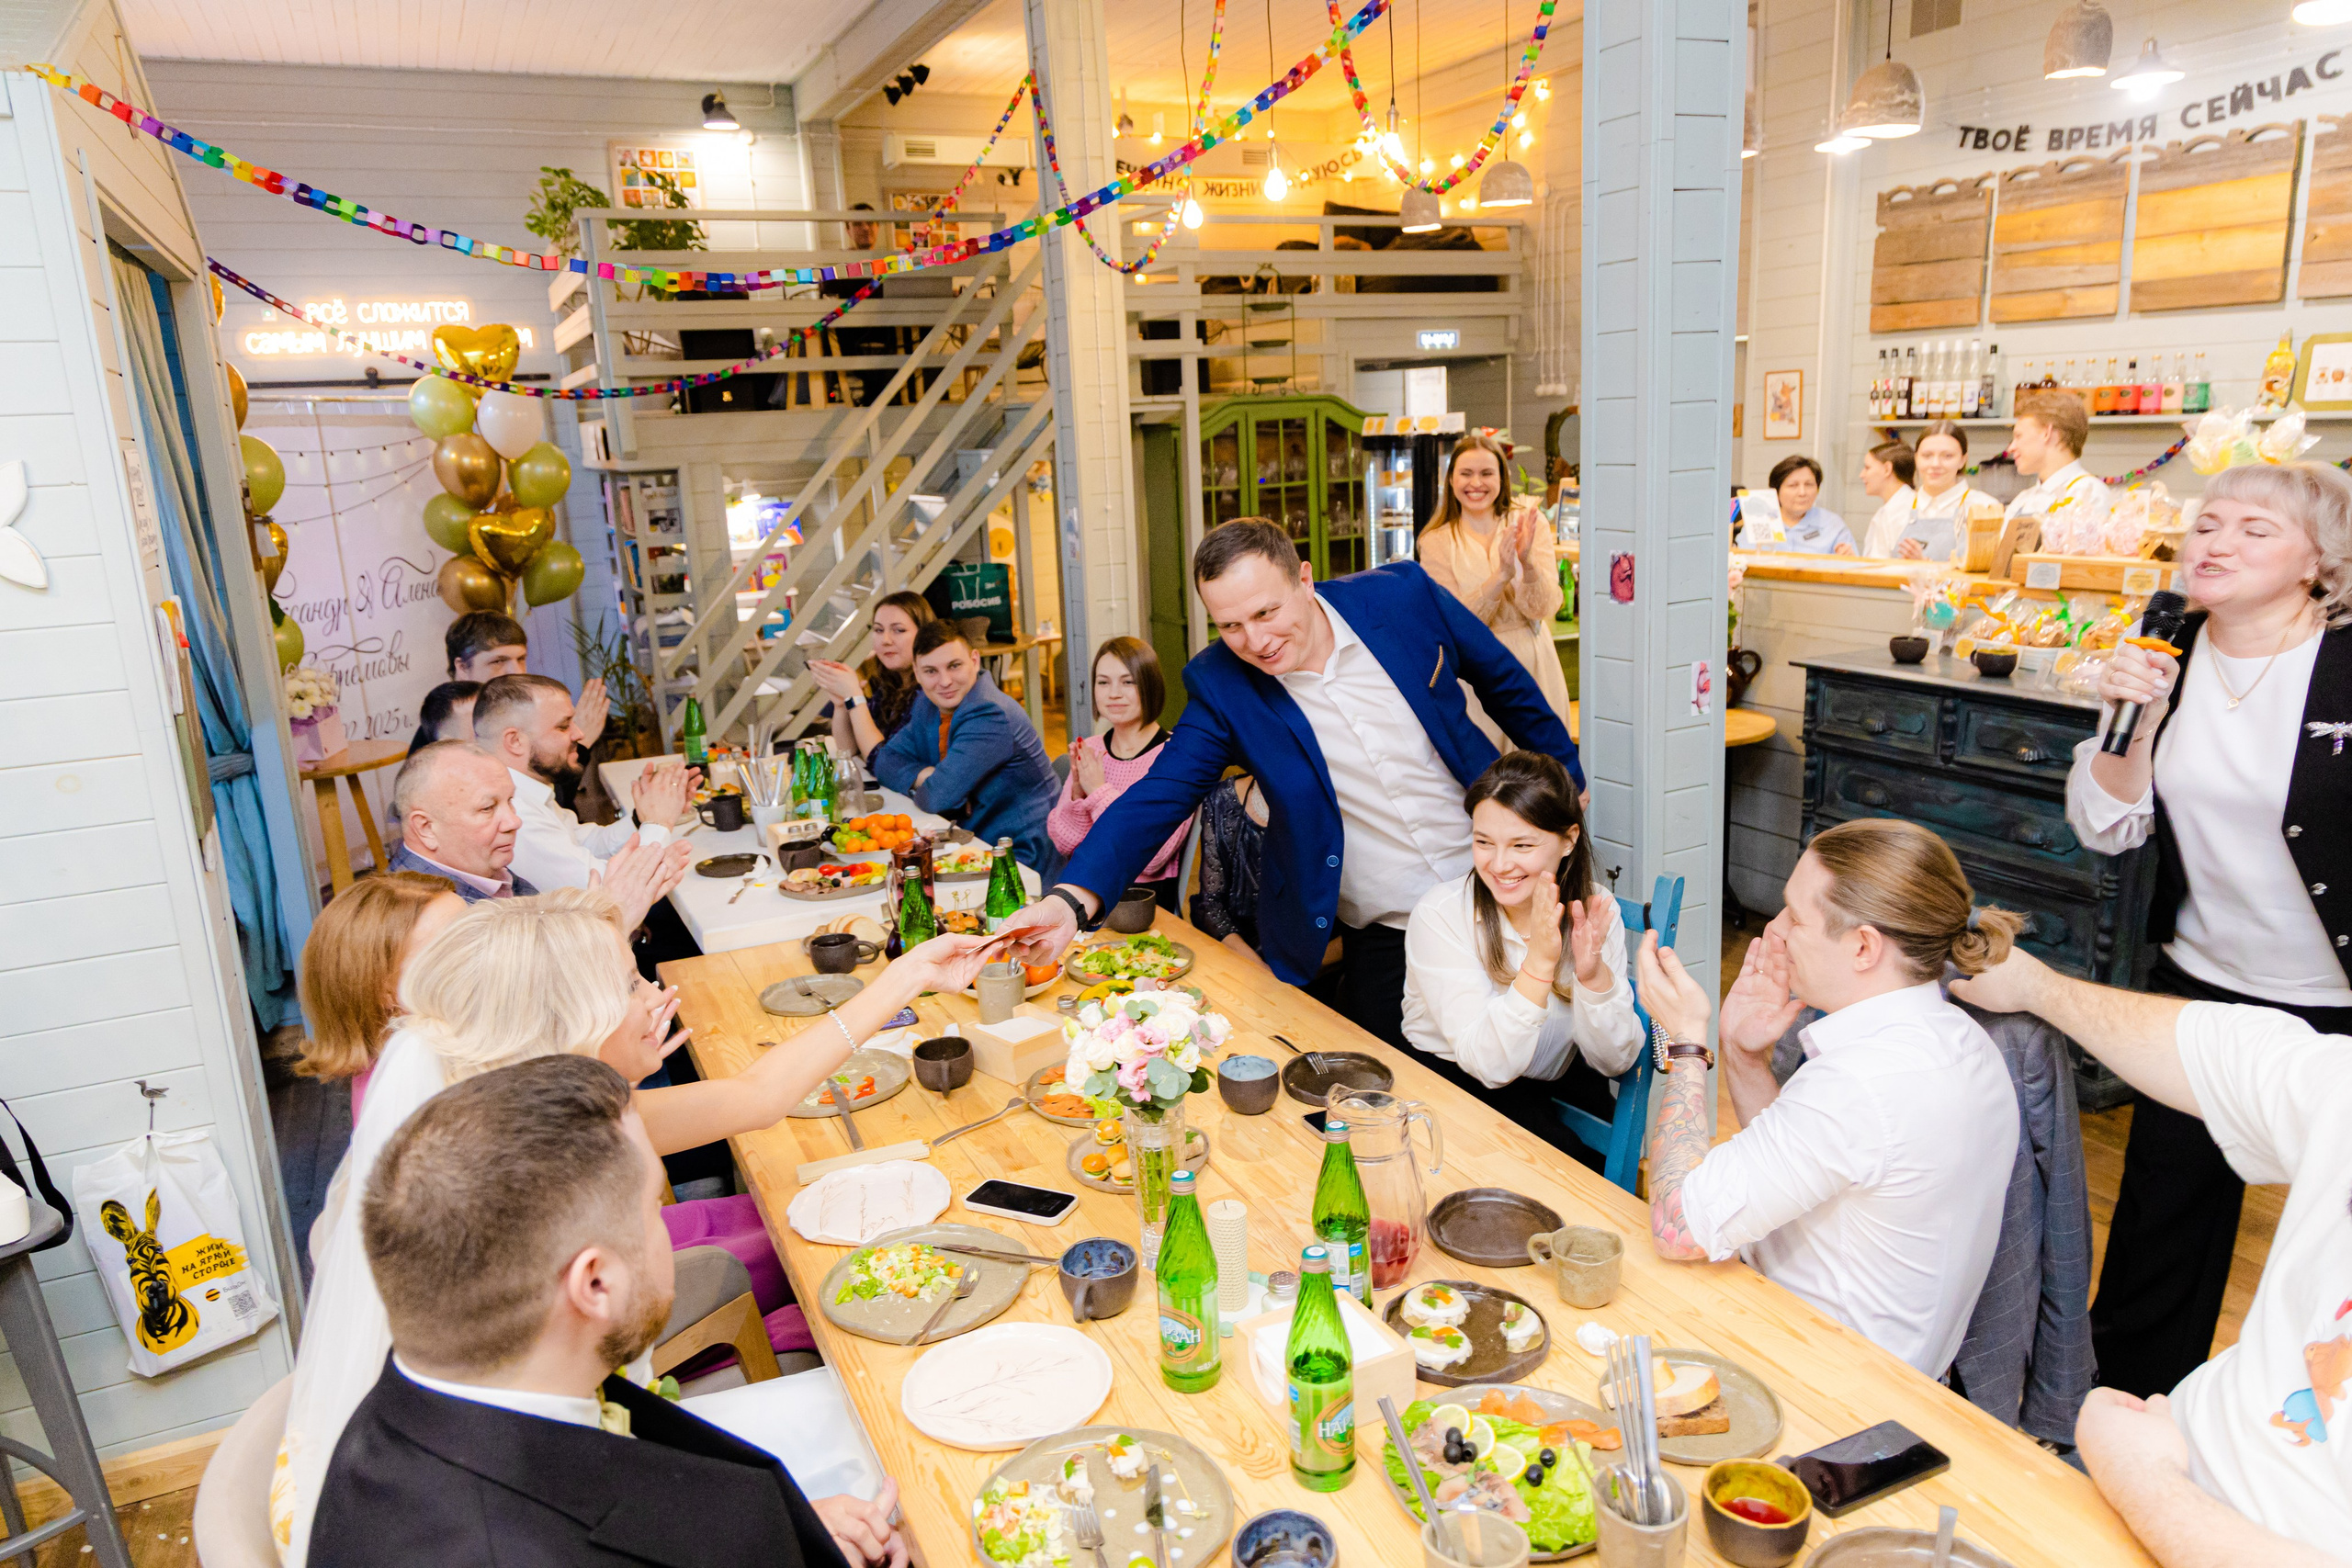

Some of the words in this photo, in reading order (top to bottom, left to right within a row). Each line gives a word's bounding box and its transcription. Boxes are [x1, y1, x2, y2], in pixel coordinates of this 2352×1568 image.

[1959, 124, 2030, 152] ТВОЁ
[2047, 113, 2158, 152] ВРЕМЯ
[2180, 50, 2344, 129] СЕЙЧАС
[1204, 180, 1262, 197] ЖИЗНИ
[181, 1262, 197, 1274] НА
[1161, 1325, 1201, 1344] РЗАН
